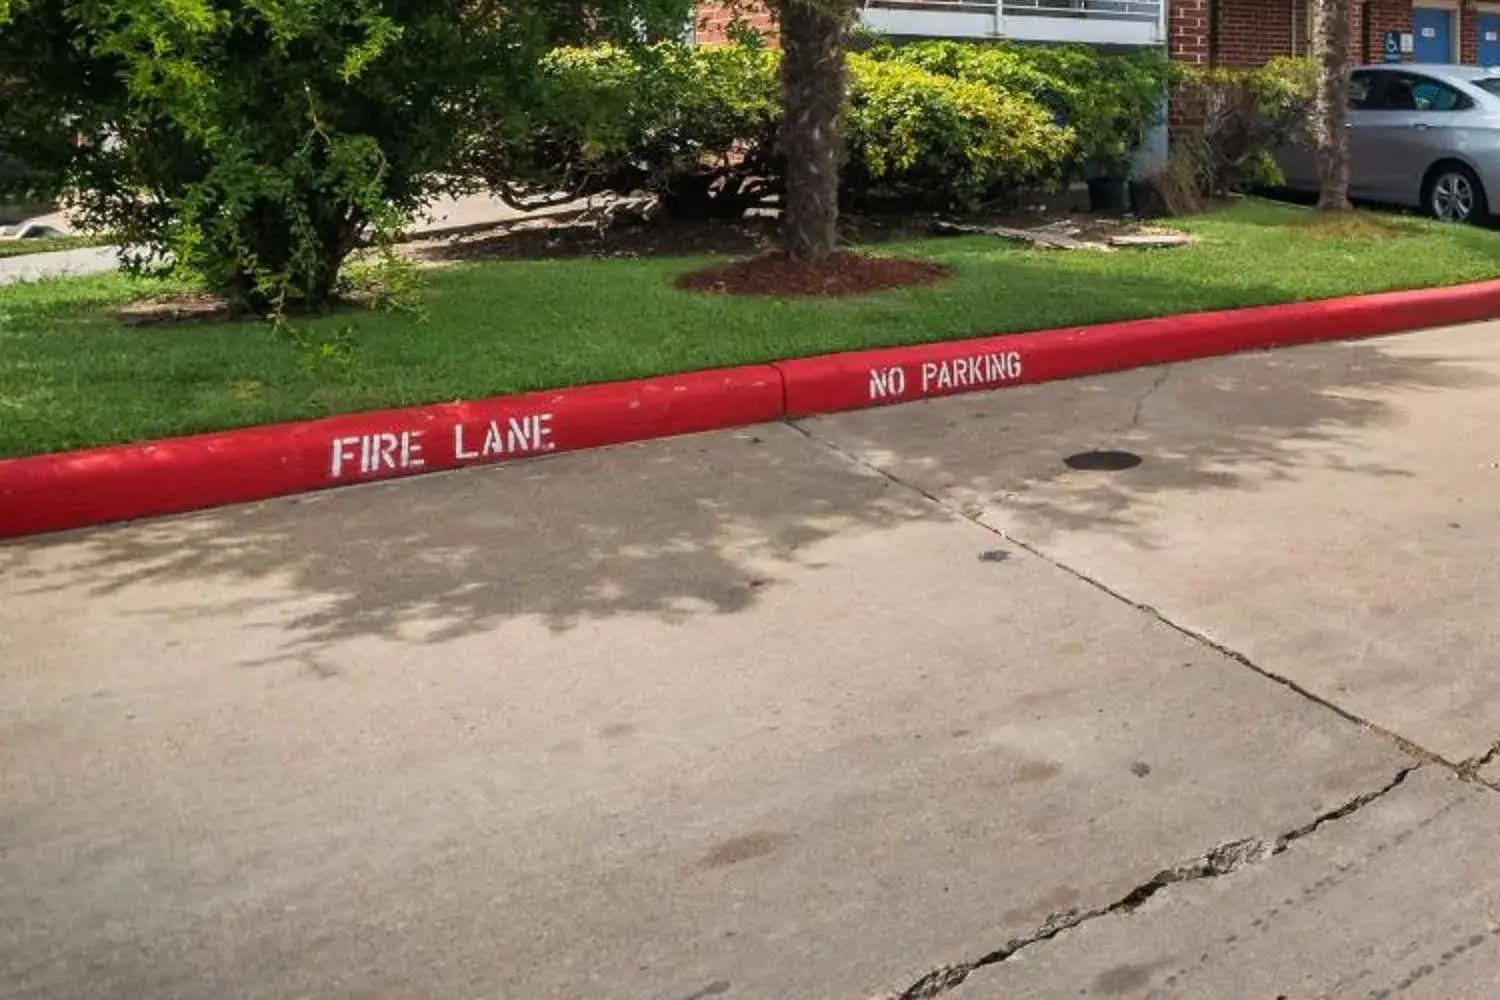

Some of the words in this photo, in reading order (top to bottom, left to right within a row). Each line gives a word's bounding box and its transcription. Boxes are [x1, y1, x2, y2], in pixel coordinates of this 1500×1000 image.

[869, 367, 905, 399] NO
[922, 351, 1022, 392] PARKING
[331, 430, 426, 477] FIRE
[454, 413, 555, 459] LANE
